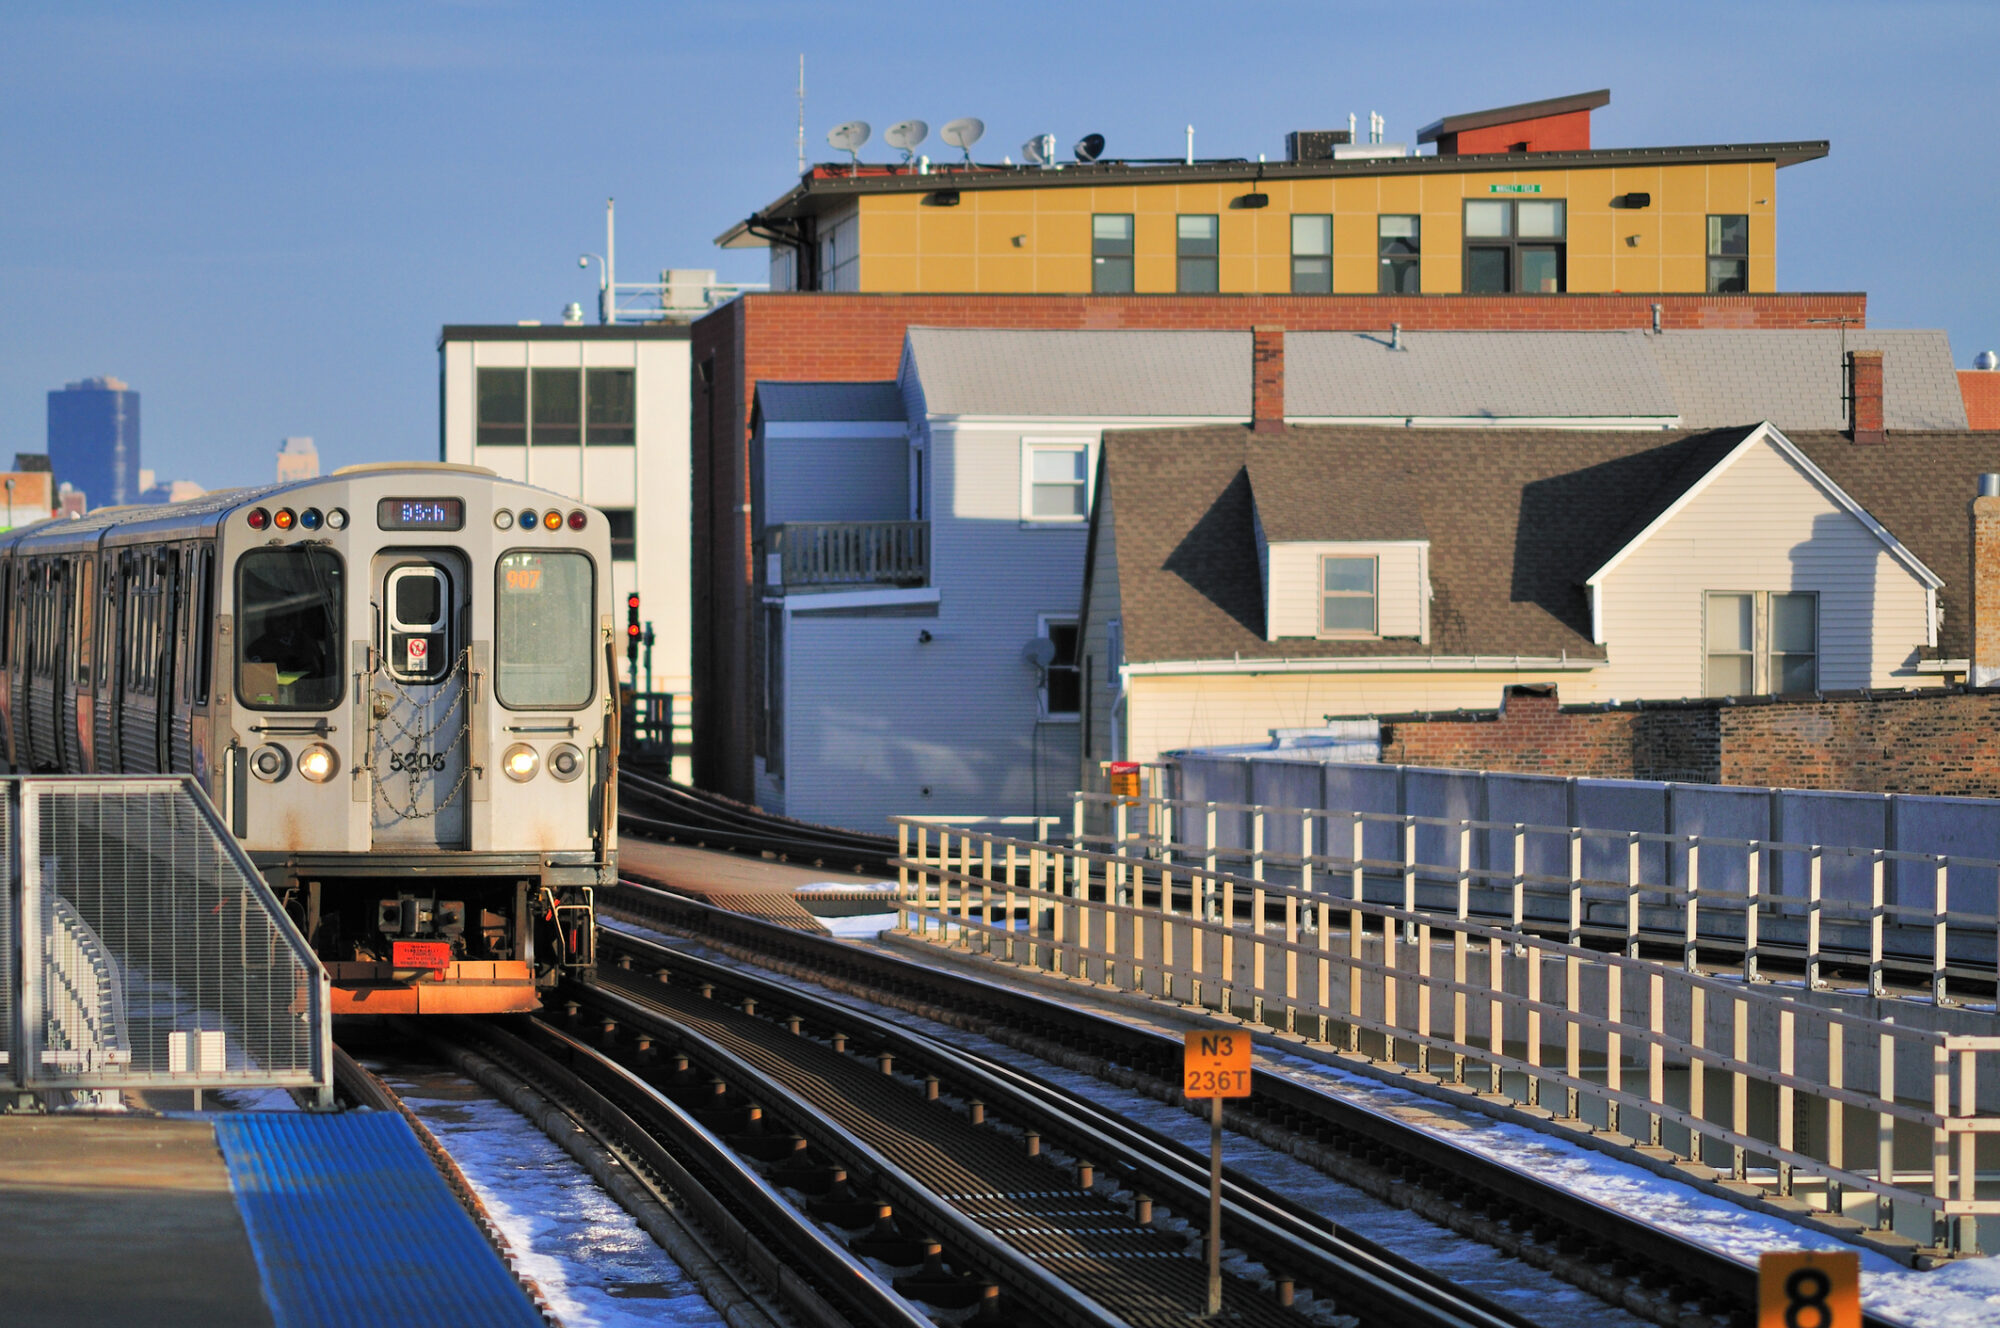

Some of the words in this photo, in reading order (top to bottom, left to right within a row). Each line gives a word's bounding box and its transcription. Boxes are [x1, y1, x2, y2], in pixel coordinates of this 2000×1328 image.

[506, 570, 541, 589] 907
[1201, 1035, 1233, 1056] N3
[1188, 1070, 1247, 1091] 236T
[1784, 1267, 1833, 1328] 8
